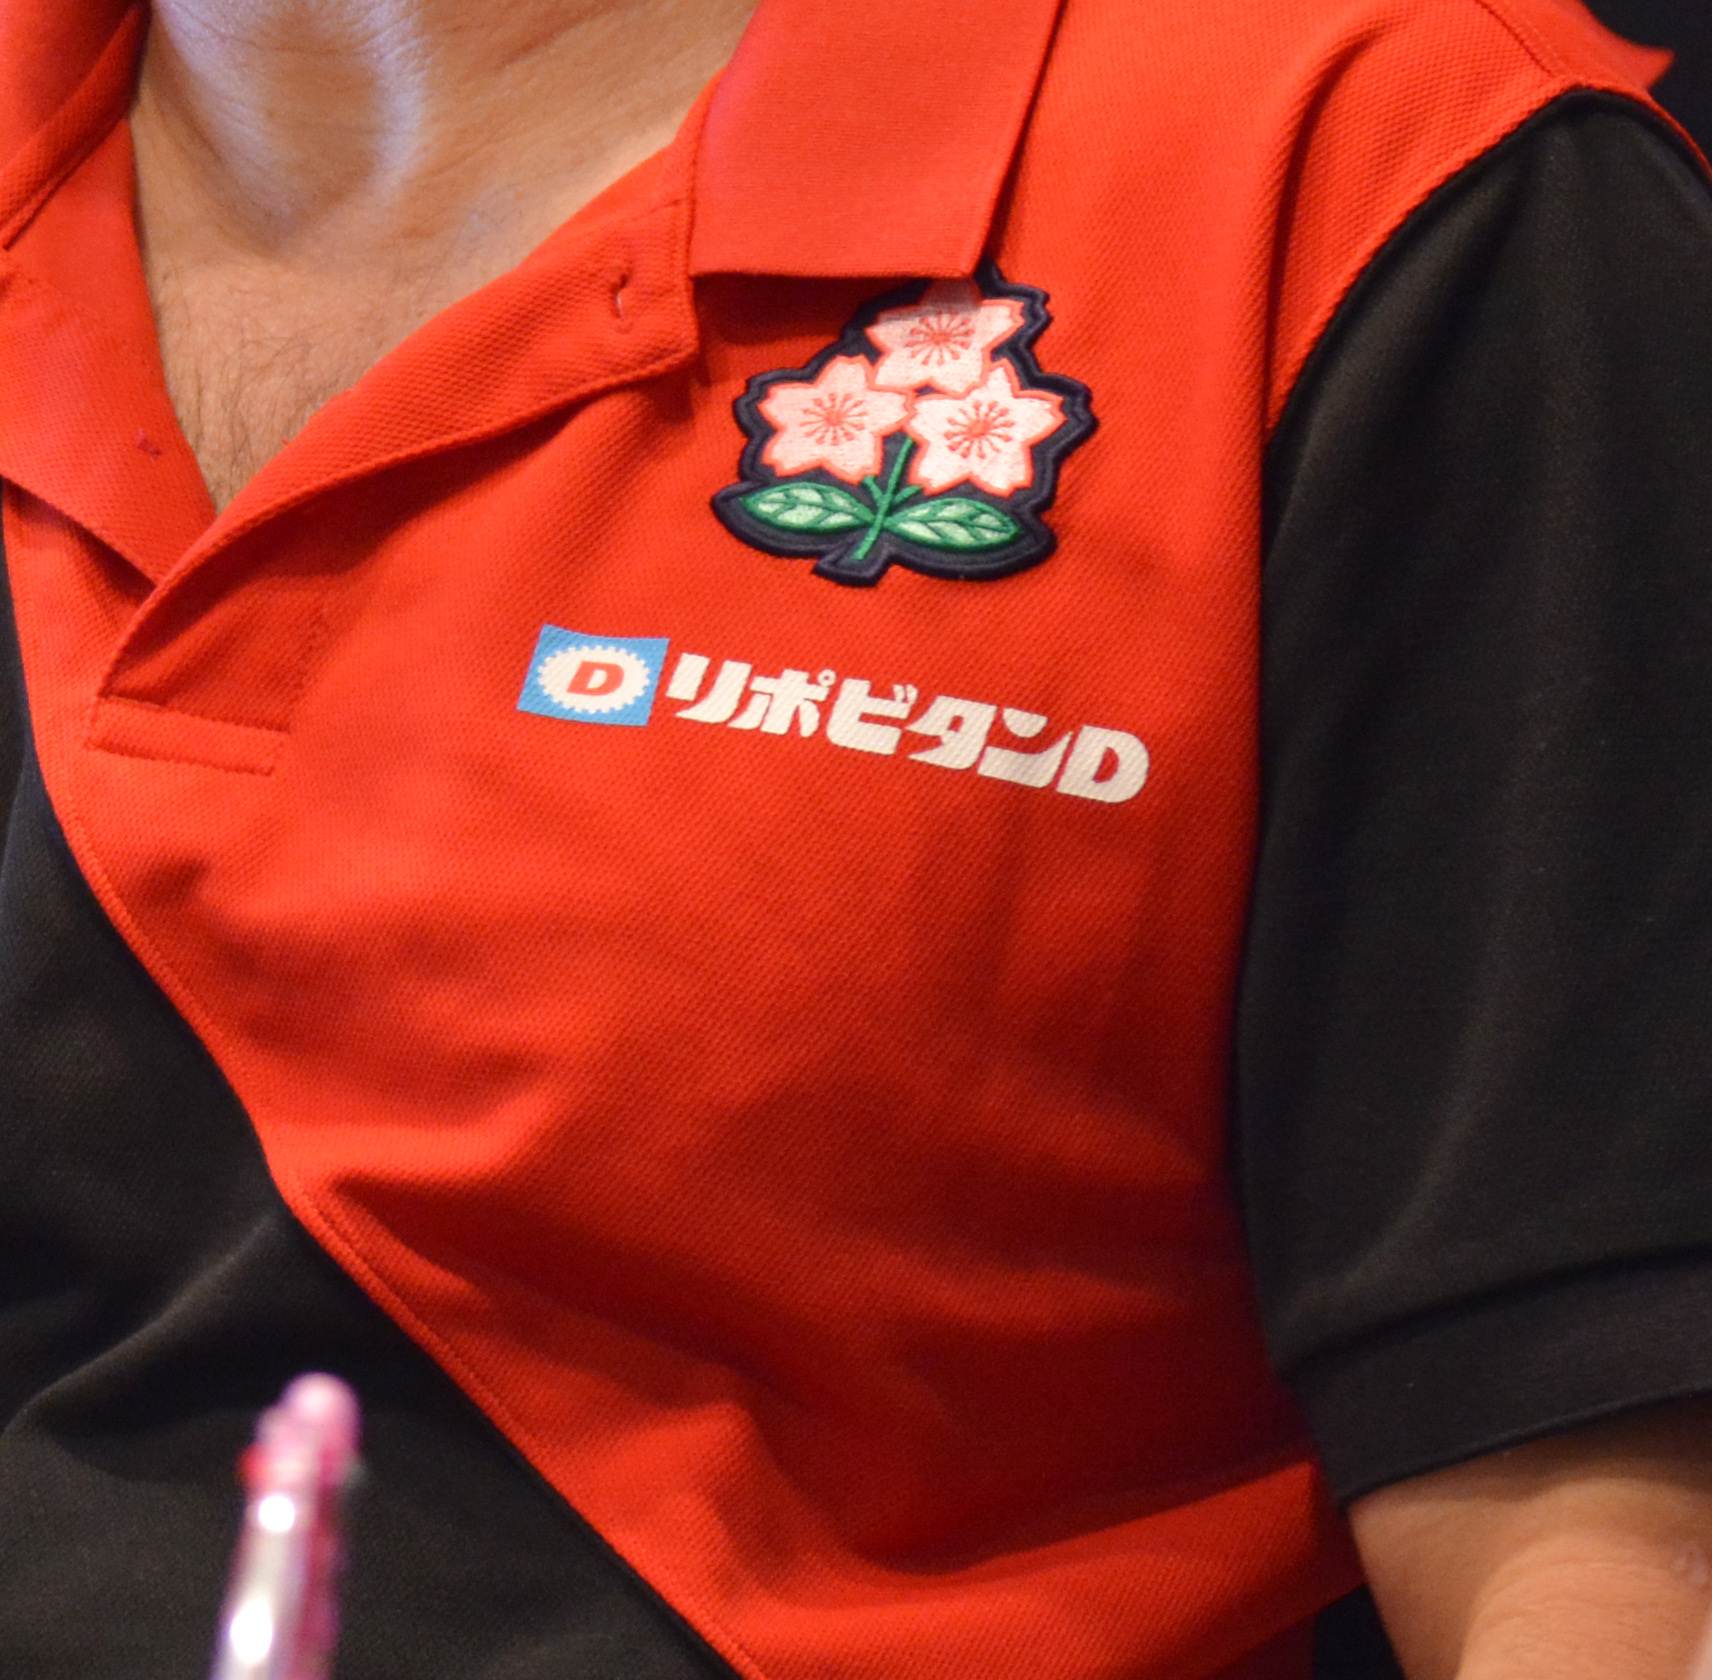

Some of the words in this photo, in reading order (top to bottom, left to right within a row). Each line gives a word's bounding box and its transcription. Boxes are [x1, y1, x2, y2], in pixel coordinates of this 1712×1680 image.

[567, 660, 626, 697] D
[666, 651, 1151, 805] リポビタンD
